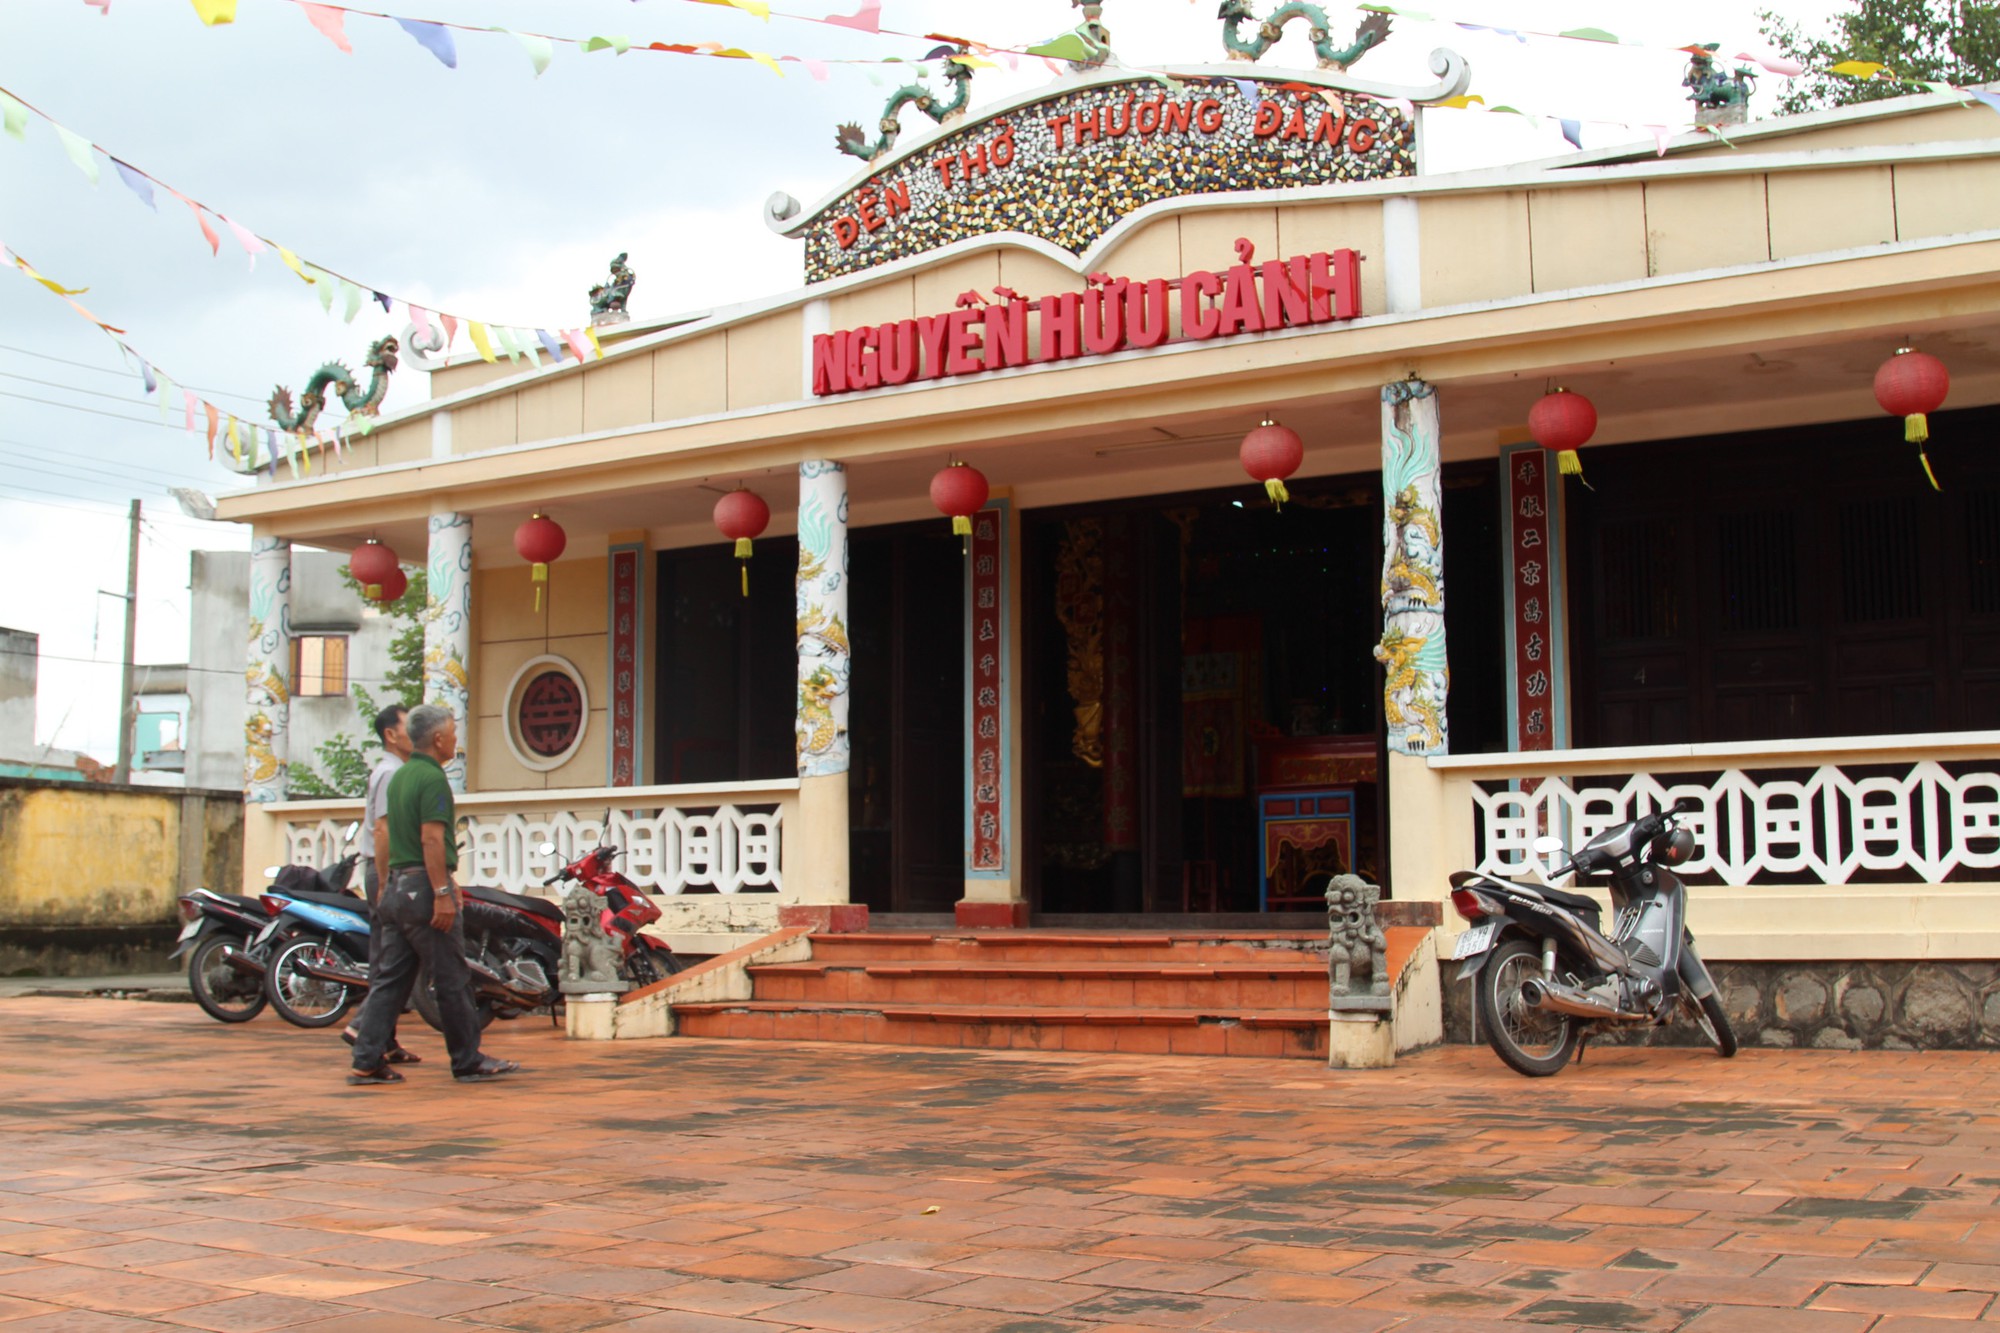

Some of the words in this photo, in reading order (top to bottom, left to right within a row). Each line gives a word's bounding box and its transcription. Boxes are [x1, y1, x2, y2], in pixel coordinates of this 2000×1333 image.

[833, 177, 911, 250] ĐỀN
[933, 118, 1015, 190] THỜ
[1047, 92, 1223, 149] THƯỢNG
[1040, 272, 1169, 361] HỮU
[1181, 237, 1362, 340] CẢNH
